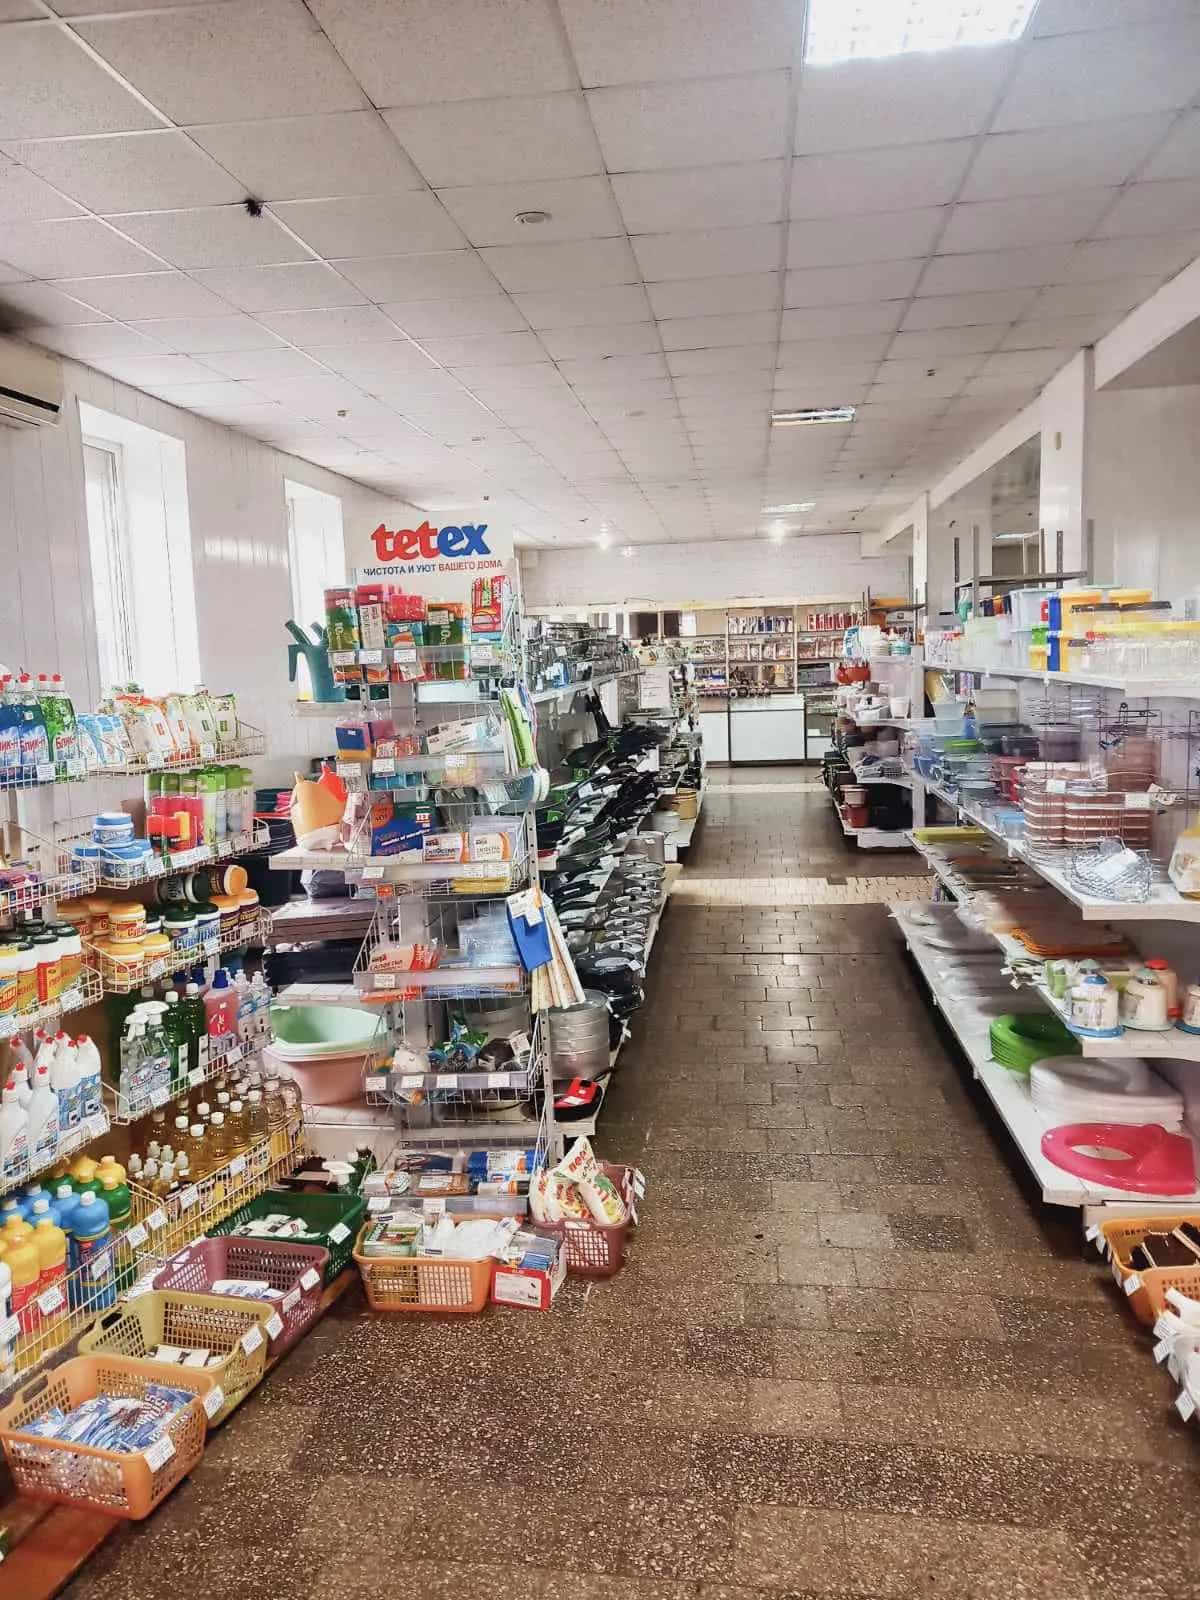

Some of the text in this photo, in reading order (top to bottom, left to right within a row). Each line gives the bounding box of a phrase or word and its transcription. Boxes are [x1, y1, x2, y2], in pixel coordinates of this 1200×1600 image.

[371, 521, 491, 561] tetex
[363, 560, 503, 576] ЧИСТОТА И УЮТ ВАШЕГО ДОМА
